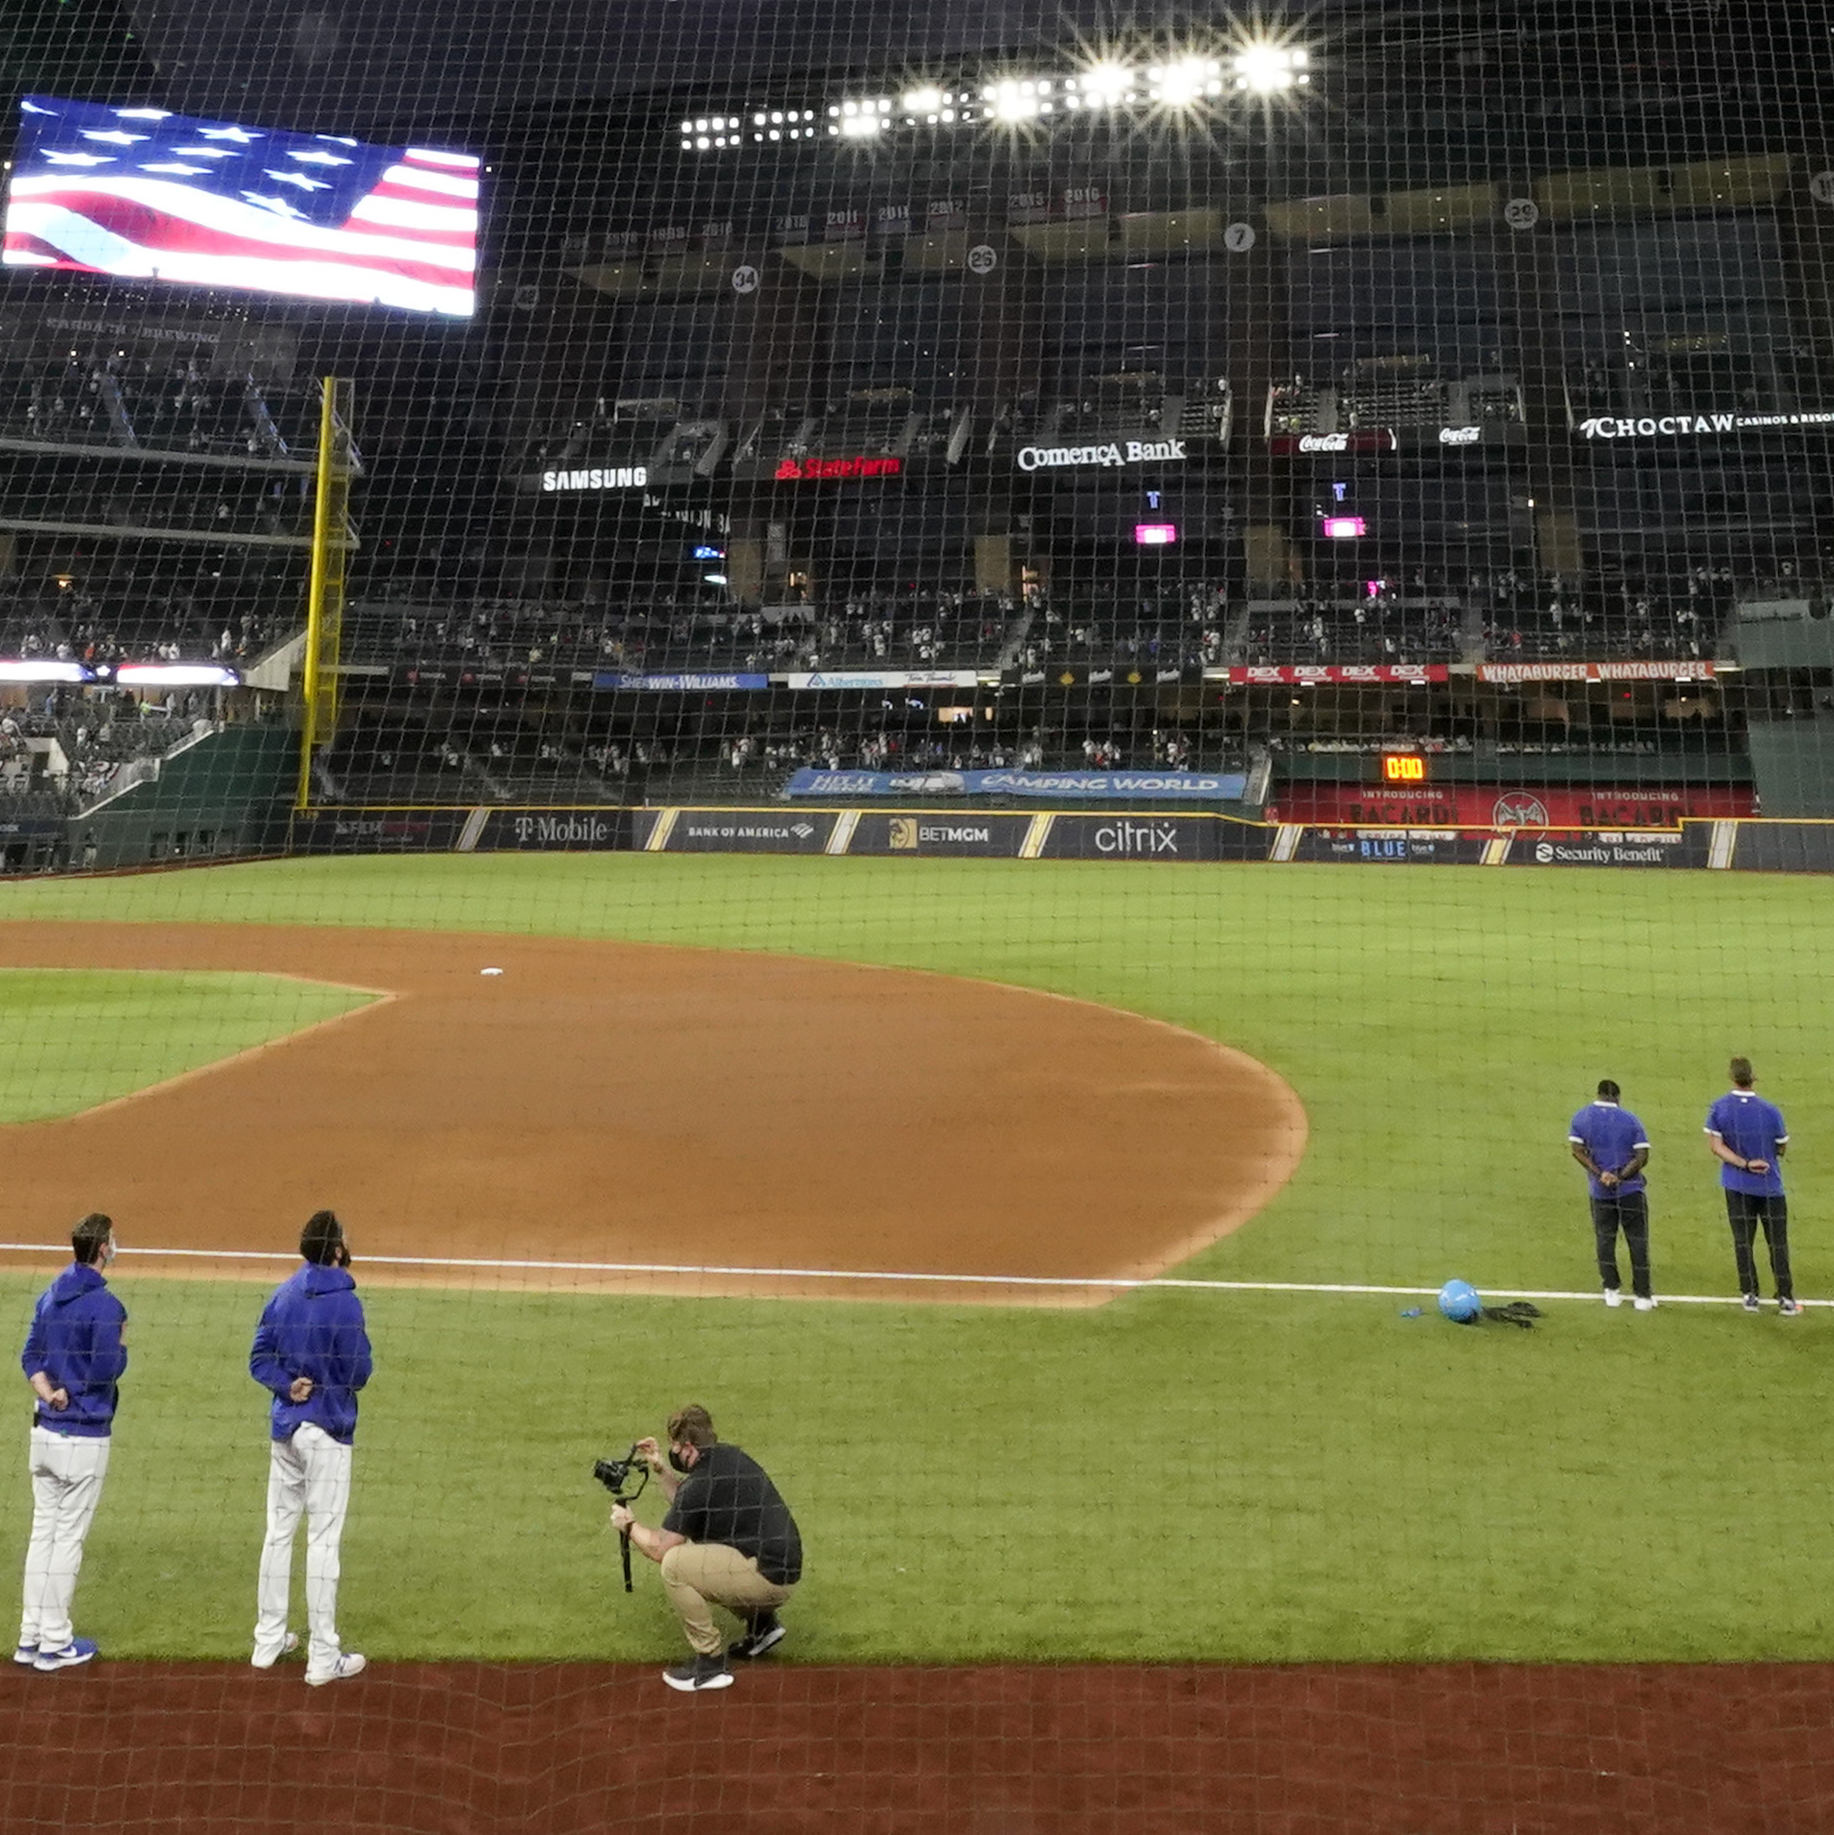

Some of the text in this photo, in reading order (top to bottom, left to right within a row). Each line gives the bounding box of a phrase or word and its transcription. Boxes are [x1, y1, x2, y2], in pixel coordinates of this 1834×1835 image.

[734, 270, 756, 288] 34
[1595, 414, 1735, 438] CHOCTAW
[1736, 415, 1788, 427] CASINOS
[1126, 438, 1187, 463] Bank
[543, 466, 647, 492] SAMSUNG
[1247, 665, 1280, 677] DEX
[1295, 665, 1328, 677] DEX
[1342, 665, 1375, 677] DEX
[1390, 664, 1425, 676] DEX
[1481, 664, 1588, 681] WHATABURGER
[1597, 662, 1707, 679] WHATABURGER
[1386, 756, 1424, 780] 0:00
[981, 773, 1219, 791] CAMPING WORLD
[1362, 790, 1444, 800] INTRODUCING
[1591, 791, 1680, 802] INTRODUCING
[688, 827, 719, 837] BANK
[737, 827, 789, 838] AMERICA
[919, 826, 989, 842] BETMGM
[1095, 822, 1178, 852] citrix
[1361, 840, 1406, 856] BLUE
[1556, 847, 1610, 864] Security
